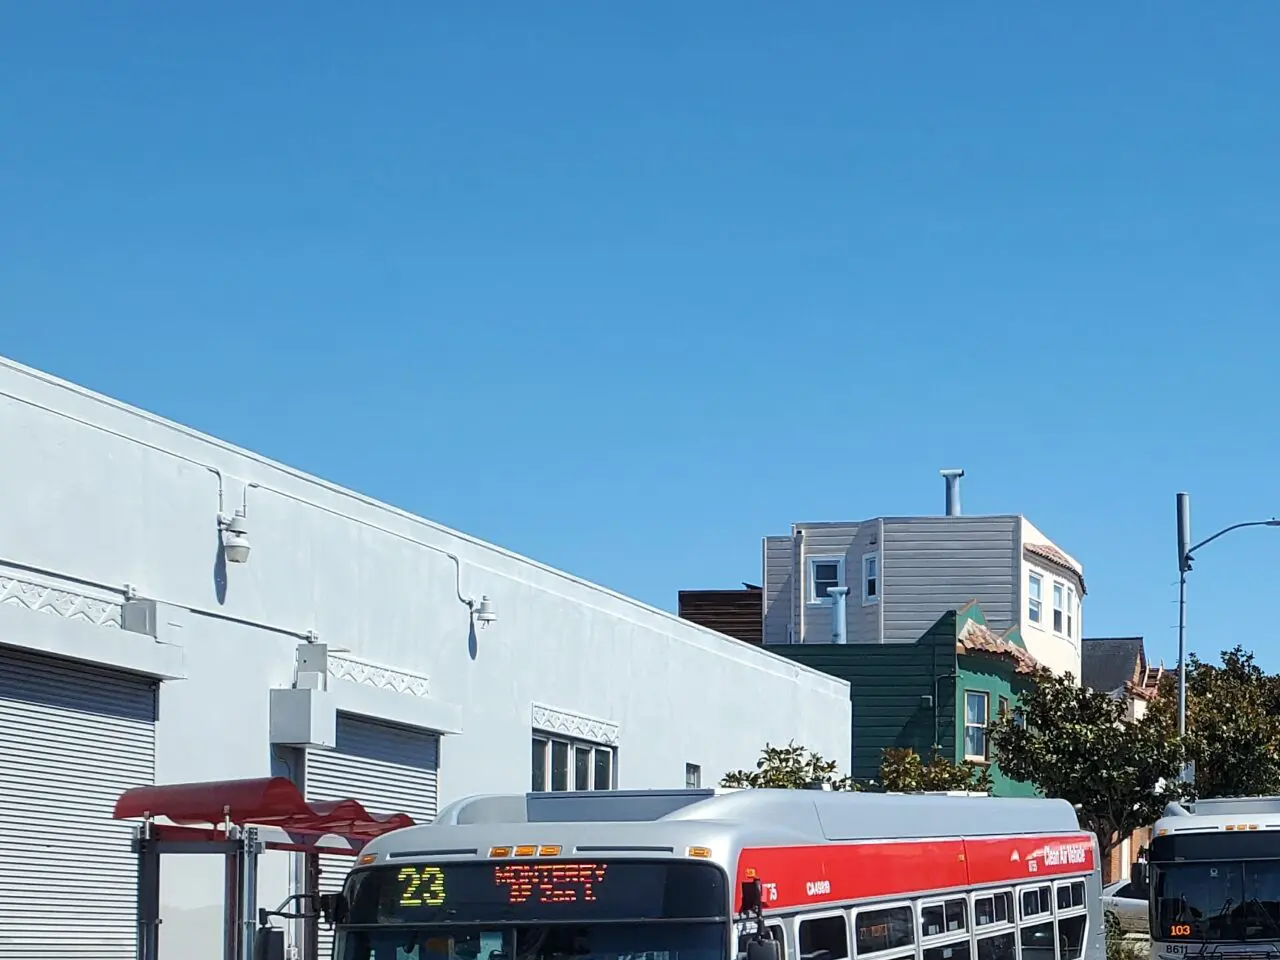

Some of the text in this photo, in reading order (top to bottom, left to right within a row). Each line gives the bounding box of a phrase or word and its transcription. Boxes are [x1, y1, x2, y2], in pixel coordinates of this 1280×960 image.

[398, 863, 608, 907] 23 MONTEREY
[1170, 924, 1191, 936] 103
[1166, 944, 1188, 954] 8611
